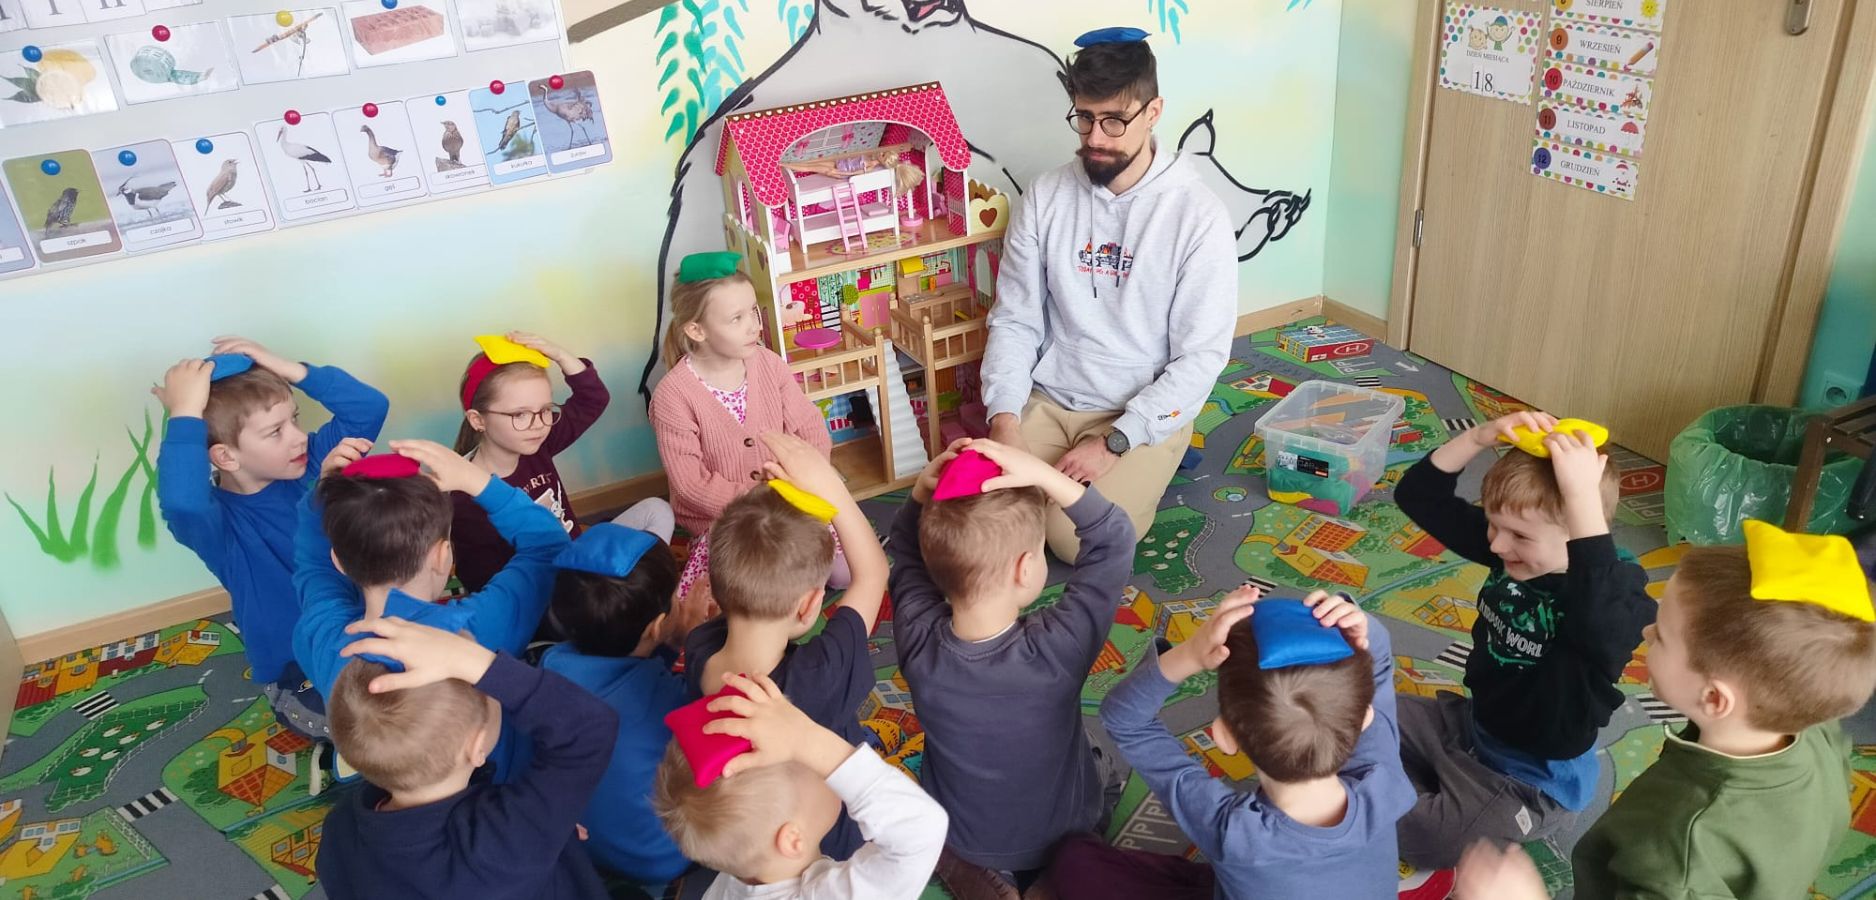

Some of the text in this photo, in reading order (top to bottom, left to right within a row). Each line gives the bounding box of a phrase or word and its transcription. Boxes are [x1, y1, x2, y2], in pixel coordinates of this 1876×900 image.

[1580, 40, 1622, 54] WRZESIEŃ
[1563, 79, 1615, 96] PAŹDZIERNIK
[1567, 120, 1606, 134] LISTOPAD
[1506, 627, 1543, 657] WORL
